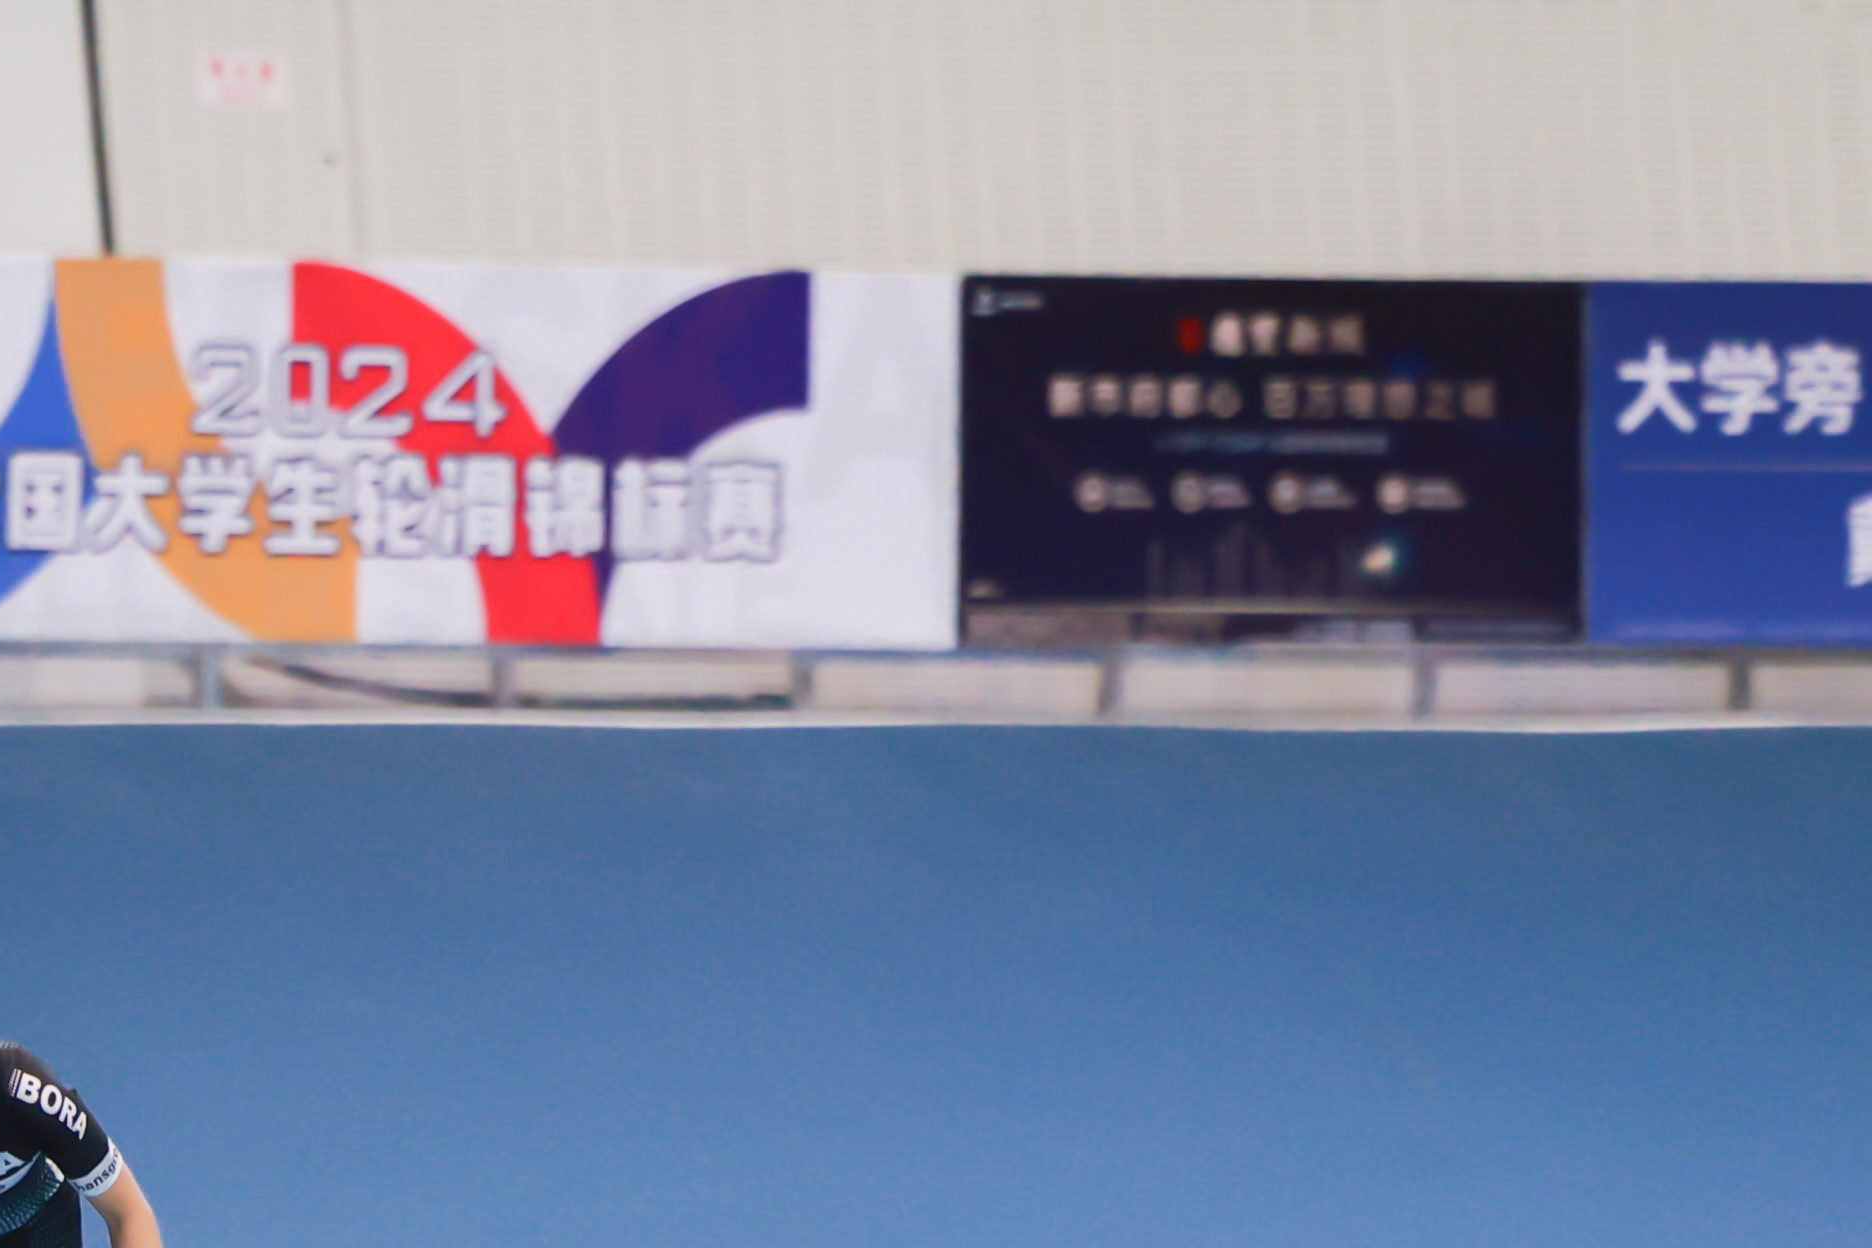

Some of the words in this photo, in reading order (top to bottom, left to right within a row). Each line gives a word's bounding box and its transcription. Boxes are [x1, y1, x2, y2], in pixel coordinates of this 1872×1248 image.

[190, 344, 506, 438] 2024
[1617, 340, 1862, 435] 大学旁
[16, 1072, 87, 1140] BORA
